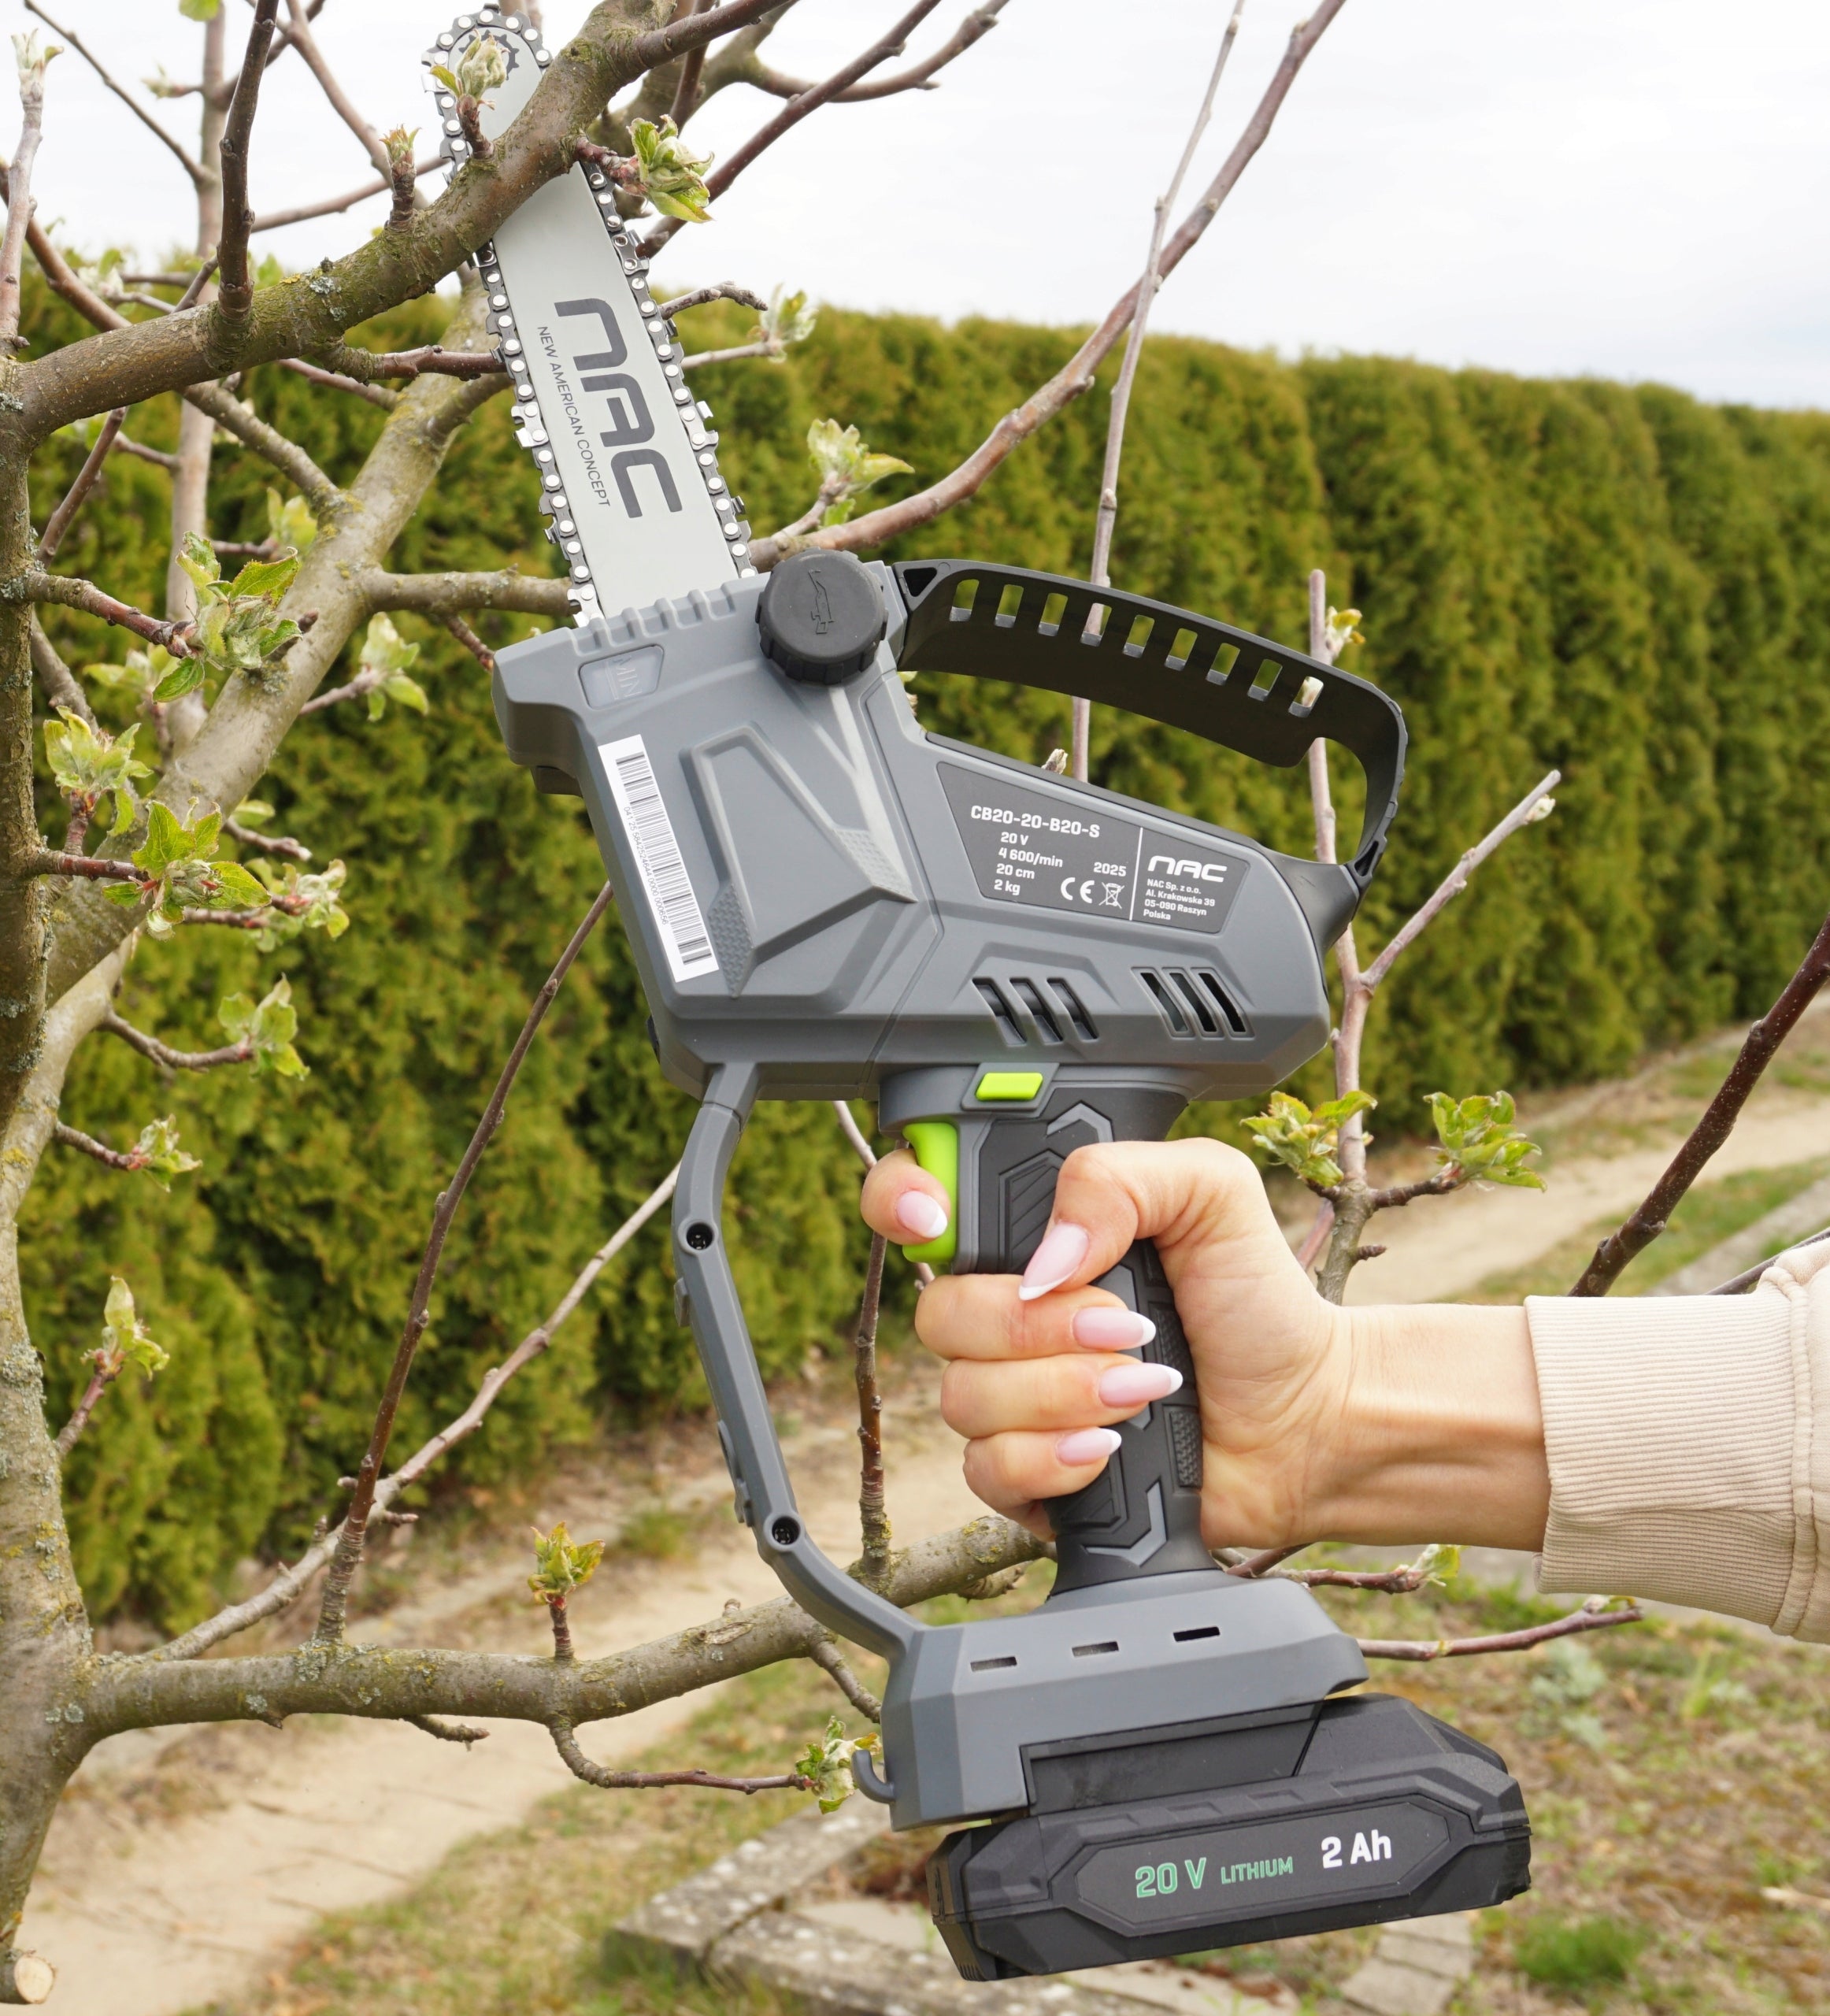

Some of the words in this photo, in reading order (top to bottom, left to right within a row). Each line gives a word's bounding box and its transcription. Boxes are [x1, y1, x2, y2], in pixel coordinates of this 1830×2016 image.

[537, 326, 558, 358] NEW
[550, 362, 585, 435] AMERICAN
[577, 439, 610, 506] CONCEPT
[971, 805, 1101, 838] CB20-20-B20-S
[1001, 832, 1017, 844] 20
[1021, 835, 1028, 846] V
[998, 847, 1007, 859] 4
[1009, 849, 1063, 867] 600/min
[996, 863, 1013, 876] 20
[1016, 869, 1035, 879] cm
[1094, 862, 1127, 876] 2025
[994, 879, 1002, 890] 2
[1005, 880, 1021, 895] kg
[1147, 878, 1164, 888] NAC
[1165, 882, 1178, 891] Sp.
[1158, 891, 1202, 905] Krakowska
[1203, 898, 1215, 906] 39
[1143, 909, 1171, 921] Polska
[1144, 899, 1176, 910] 05-090
[1177, 904, 1207, 917] Raszyn
[1135, 1862, 1177, 1899] 20
[1184, 1857, 1207, 1889] V
[1221, 1856, 1294, 1884] LITHIUM
[1321, 1836, 1343, 1869] 2
[1350, 1829, 1392, 1864] Ah
